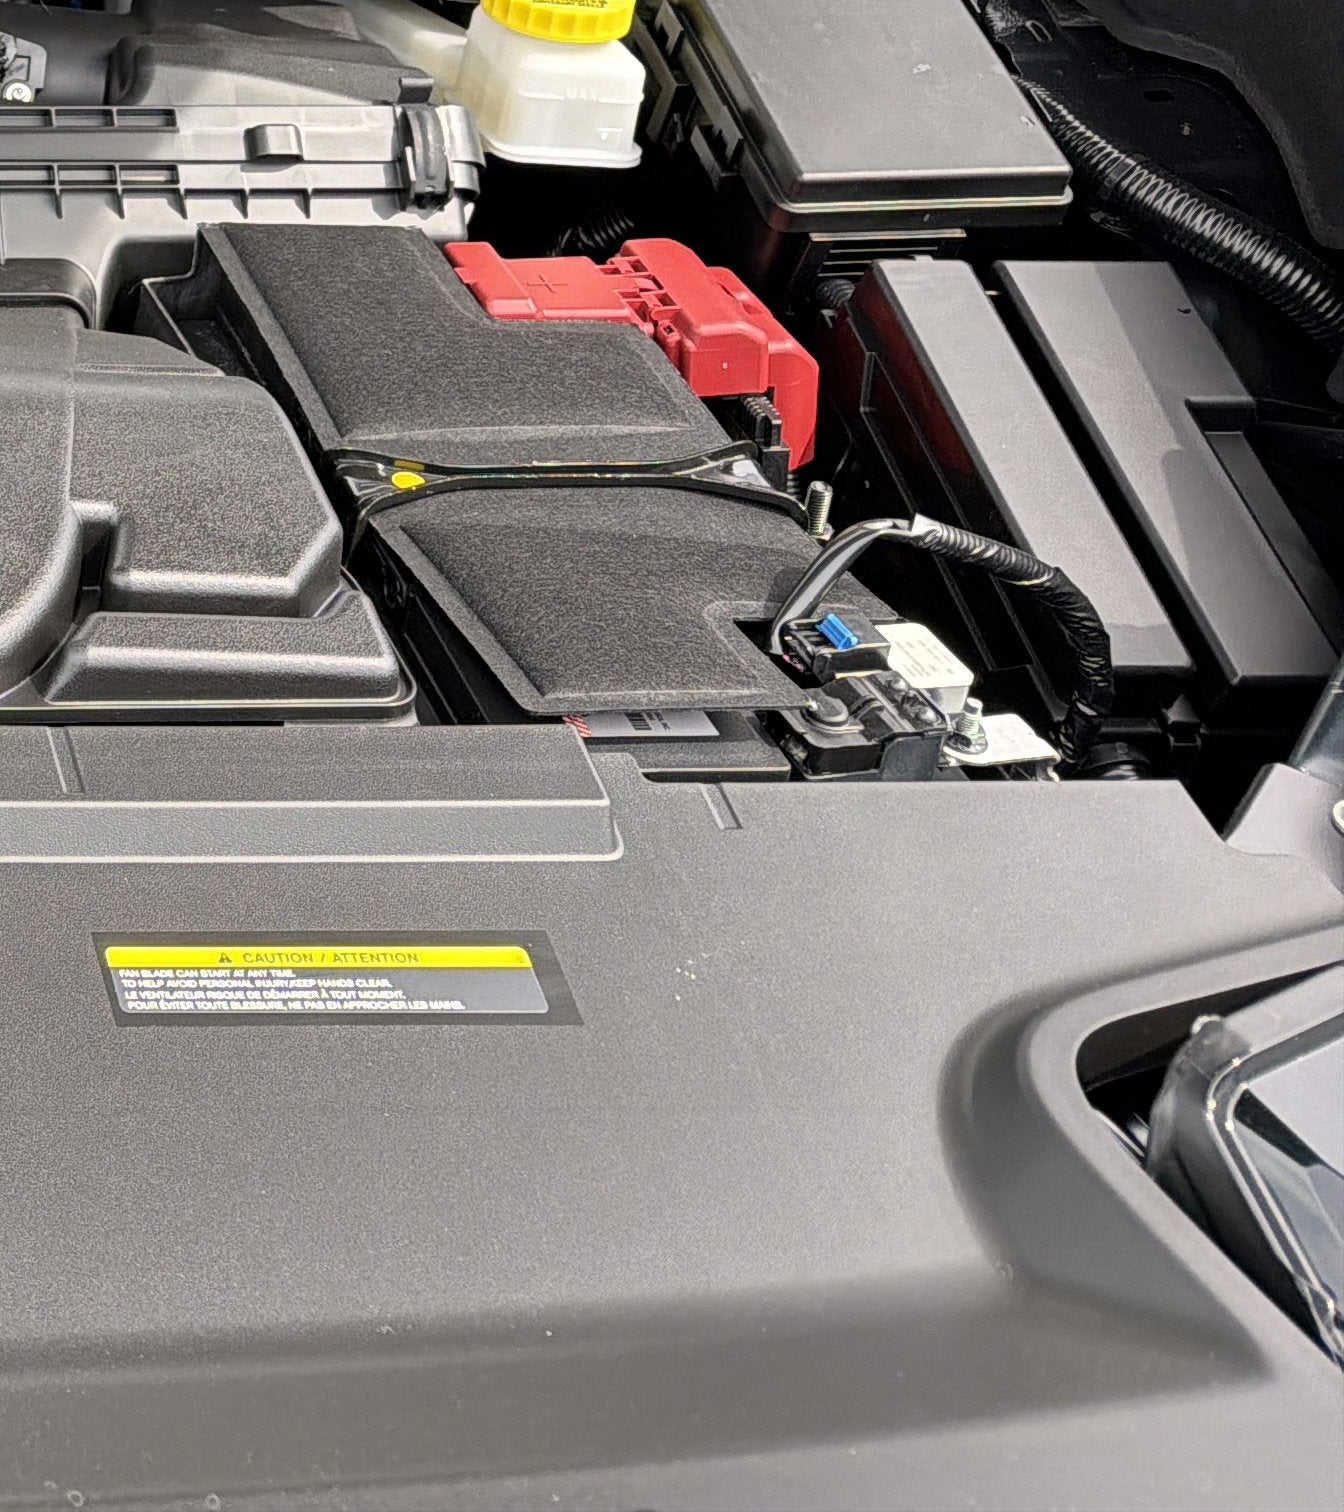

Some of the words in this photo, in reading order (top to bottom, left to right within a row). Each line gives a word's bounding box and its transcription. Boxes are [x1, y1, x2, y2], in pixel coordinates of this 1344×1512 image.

[242, 952, 314, 963] CAUTION
[320, 952, 325, 963] /
[333, 952, 419, 963] ATTENTION
[118, 969, 140, 978] FAN
[175, 969, 199, 978] CAN
[199, 969, 231, 978] START
[233, 969, 245, 978] AT
[247, 969, 268, 978] ANY
[121, 979, 137, 988] TO
[137, 979, 165, 988] HELP
[198, 979, 255, 988] PERSONAL
[317, 979, 355, 988] HANDS
[124, 990, 138, 999] LE
[138, 990, 205, 999] VENTILATEUR
[245, 990, 262, 999] DE
[329, 990, 357, 999] TOUT
[127, 1000, 159, 1010] POUR
[194, 1000, 230, 1010] TOUTE
[287, 1000, 303, 1010] NE
[303, 1000, 326, 1010] PAS
[325, 1000, 343, 1010] EN
[342, 1000, 408, 1010] APPROCHER
[407, 1000, 429, 1010] LES
